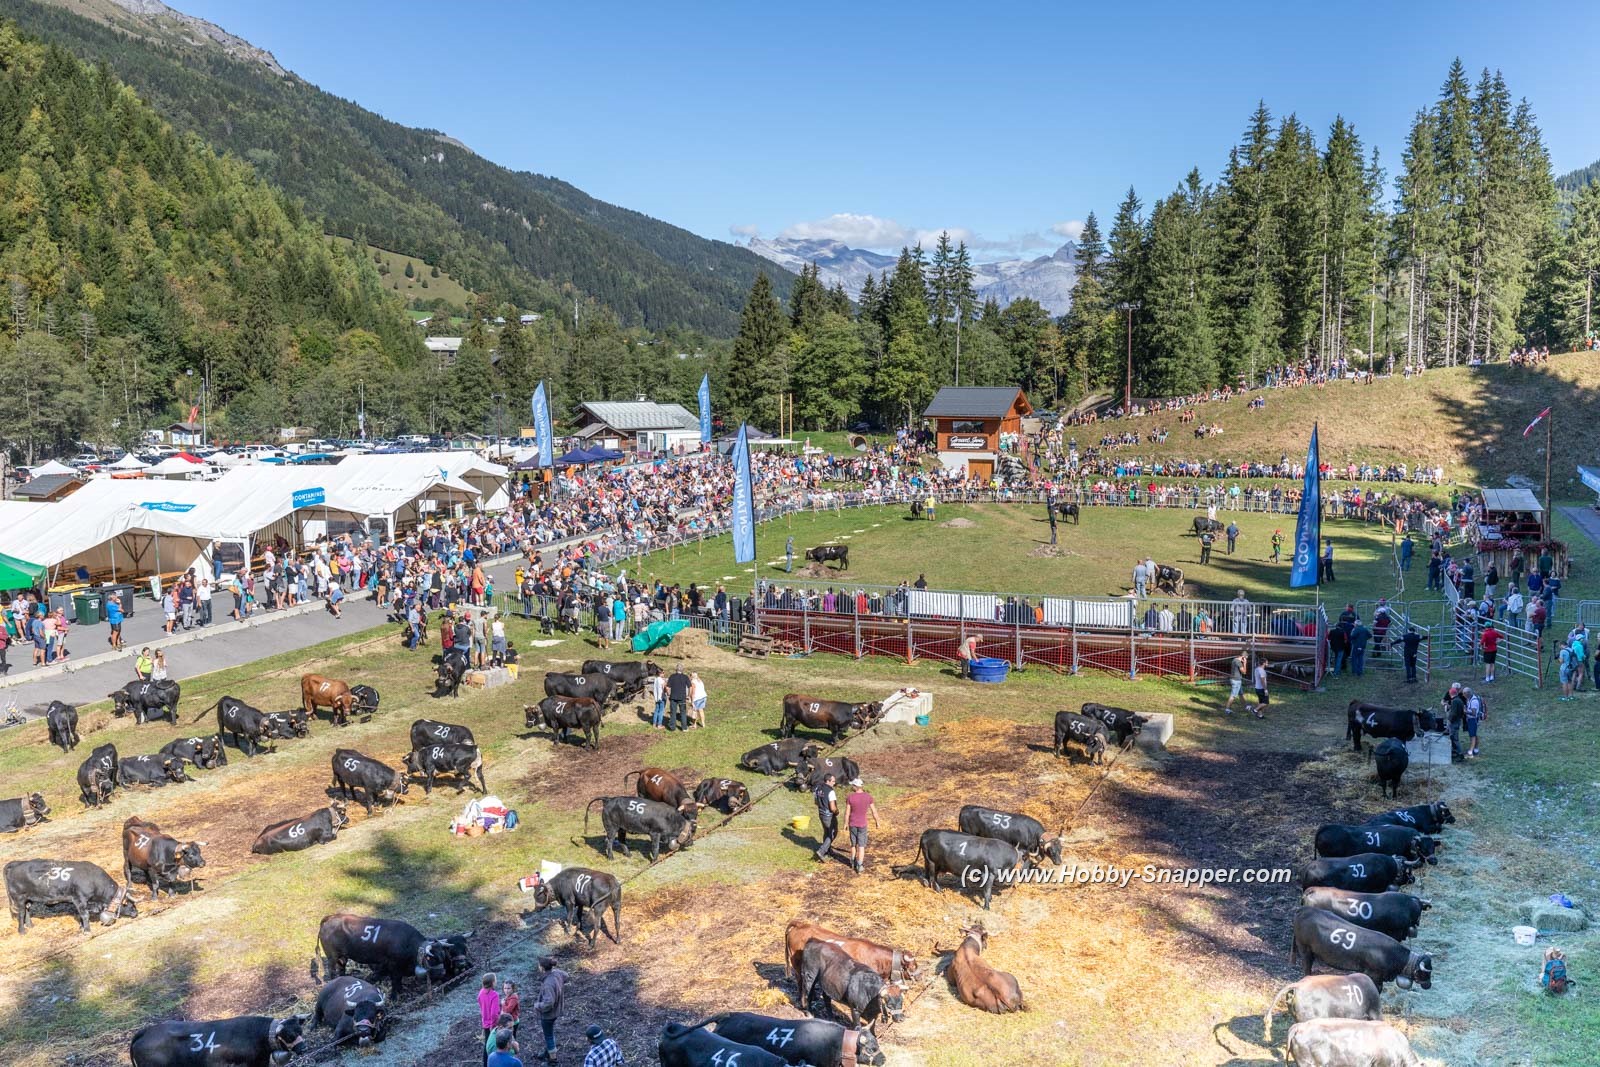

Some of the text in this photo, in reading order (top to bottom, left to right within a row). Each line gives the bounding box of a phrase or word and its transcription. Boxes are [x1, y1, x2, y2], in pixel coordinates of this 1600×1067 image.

[603, 664, 611, 674] 9
[574, 677, 586, 685] 10
[809, 702, 820, 713] 19
[1102, 709, 1117, 725] 73
[1366, 712, 1378, 728] 4
[434, 725, 451, 738] 28
[1069, 720, 1085, 734] 55
[431, 746, 445, 760] 84
[344, 758, 361, 772] 65
[825, 758, 833, 767] 6
[627, 800, 647, 815] 56
[992, 813, 1012, 829] 53
[288, 823, 305, 838] 66
[1365, 831, 1381, 847] 31
[959, 841, 968, 856] 1
[50, 867, 75, 881] 36
[1348, 863, 1367, 878] 32
[1346, 898, 1373, 920] 30
[361, 925, 381, 943] 51
[1330, 928, 1357, 950] 69
[1341, 984, 1363, 1006] 70
[190, 1032, 221, 1054] 34
[766, 1027, 795, 1048] 47
[711, 1048, 742, 1067] 46
